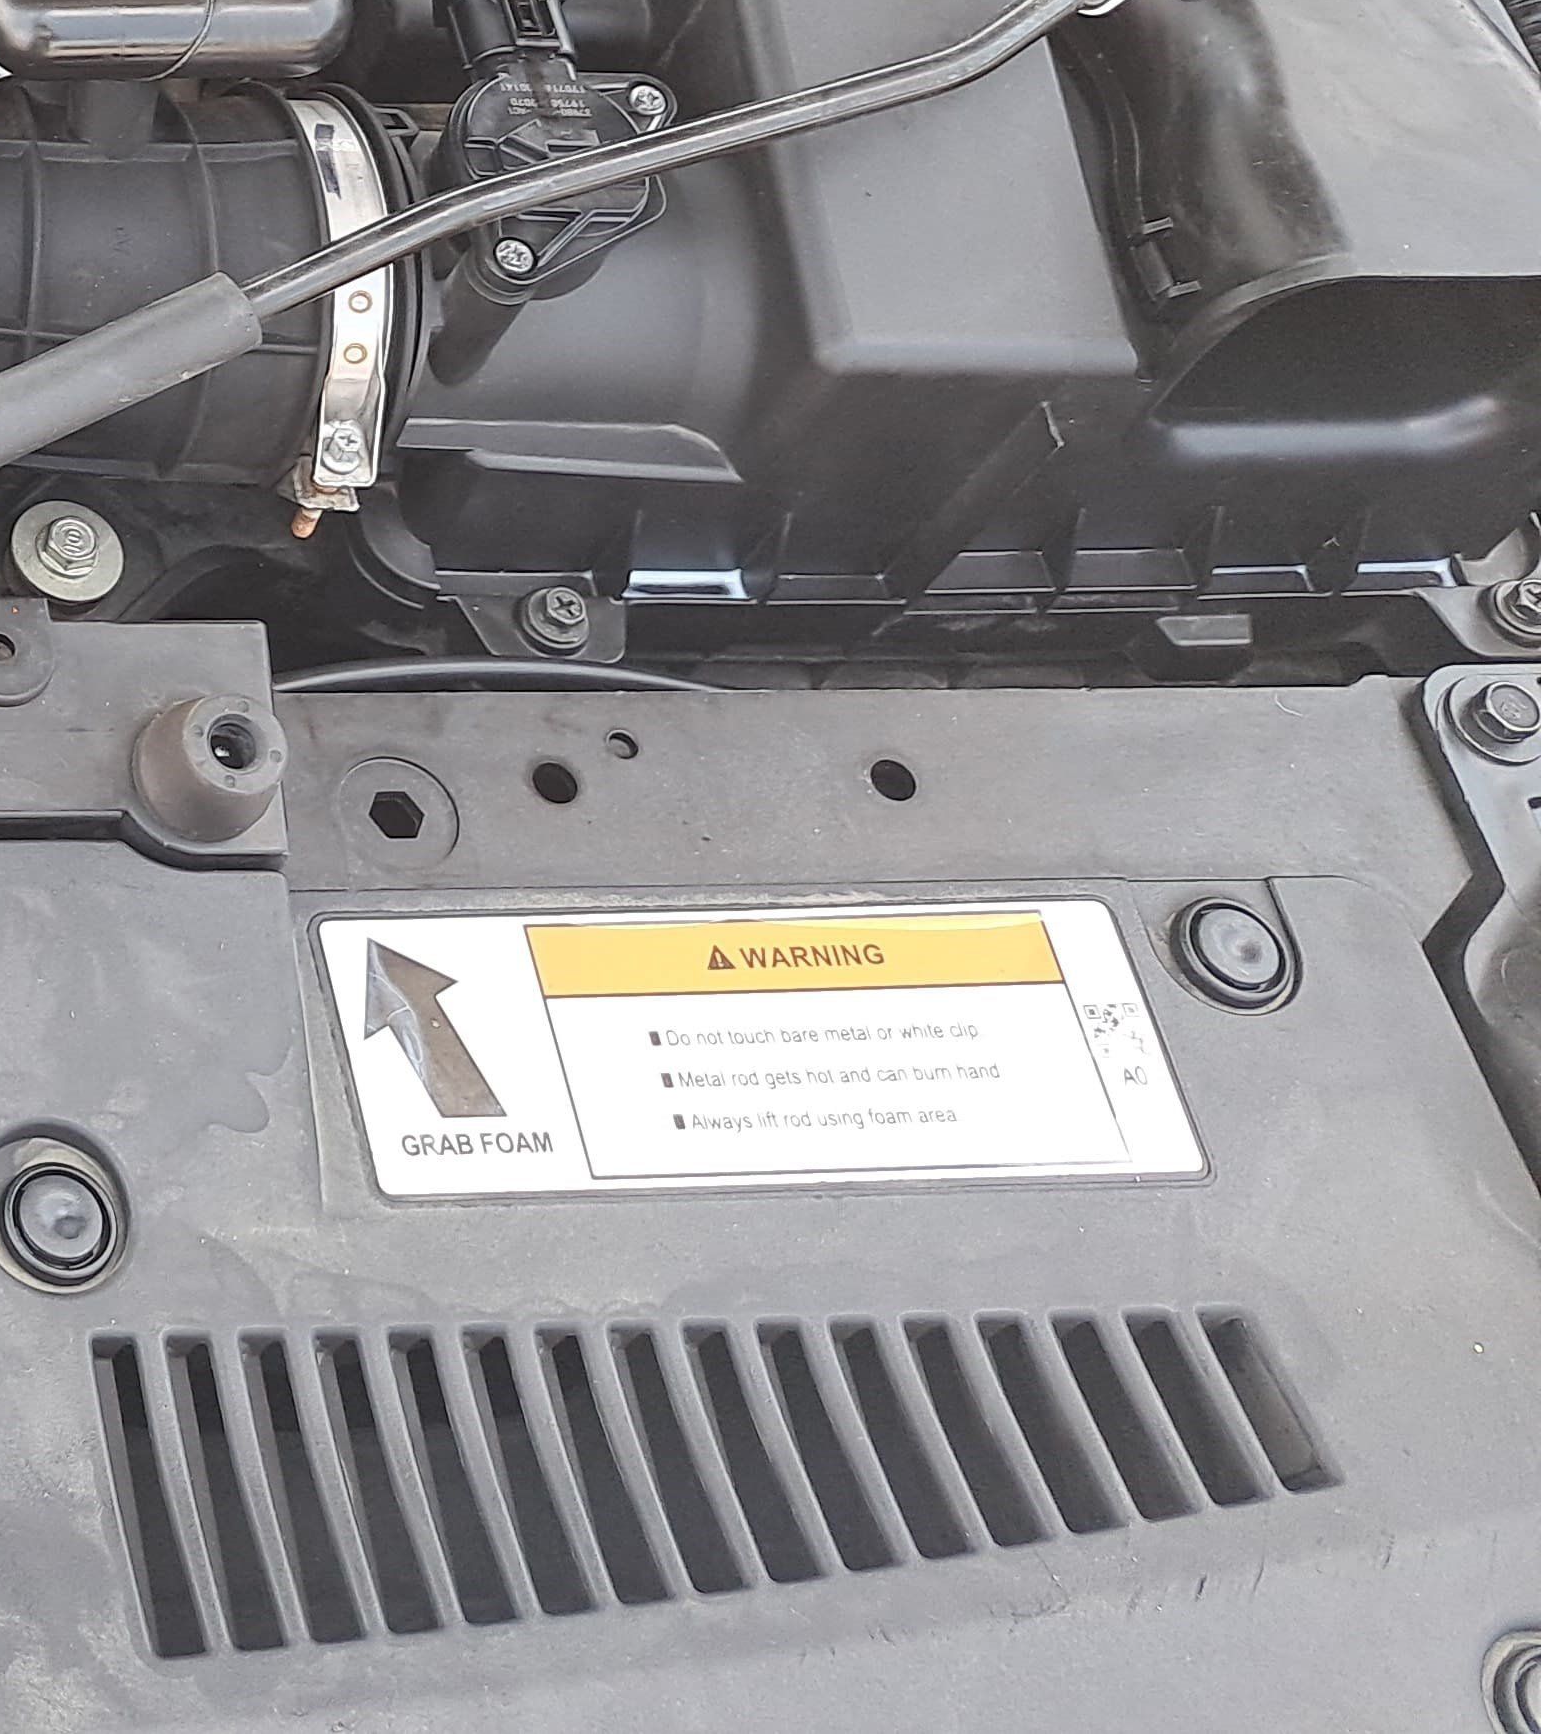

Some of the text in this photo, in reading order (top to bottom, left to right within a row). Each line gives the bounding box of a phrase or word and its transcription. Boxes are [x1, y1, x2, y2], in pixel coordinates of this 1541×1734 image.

[739, 943, 885, 969] WARNING
[666, 1020, 979, 1047] Do not touch bare metal or white clip
[678, 1063, 1001, 1091] Metal rod gets hot and can burn hand
[691, 1108, 957, 1133] Always lift rod using foam area
[401, 1131, 554, 1156] GRAB FOAM
